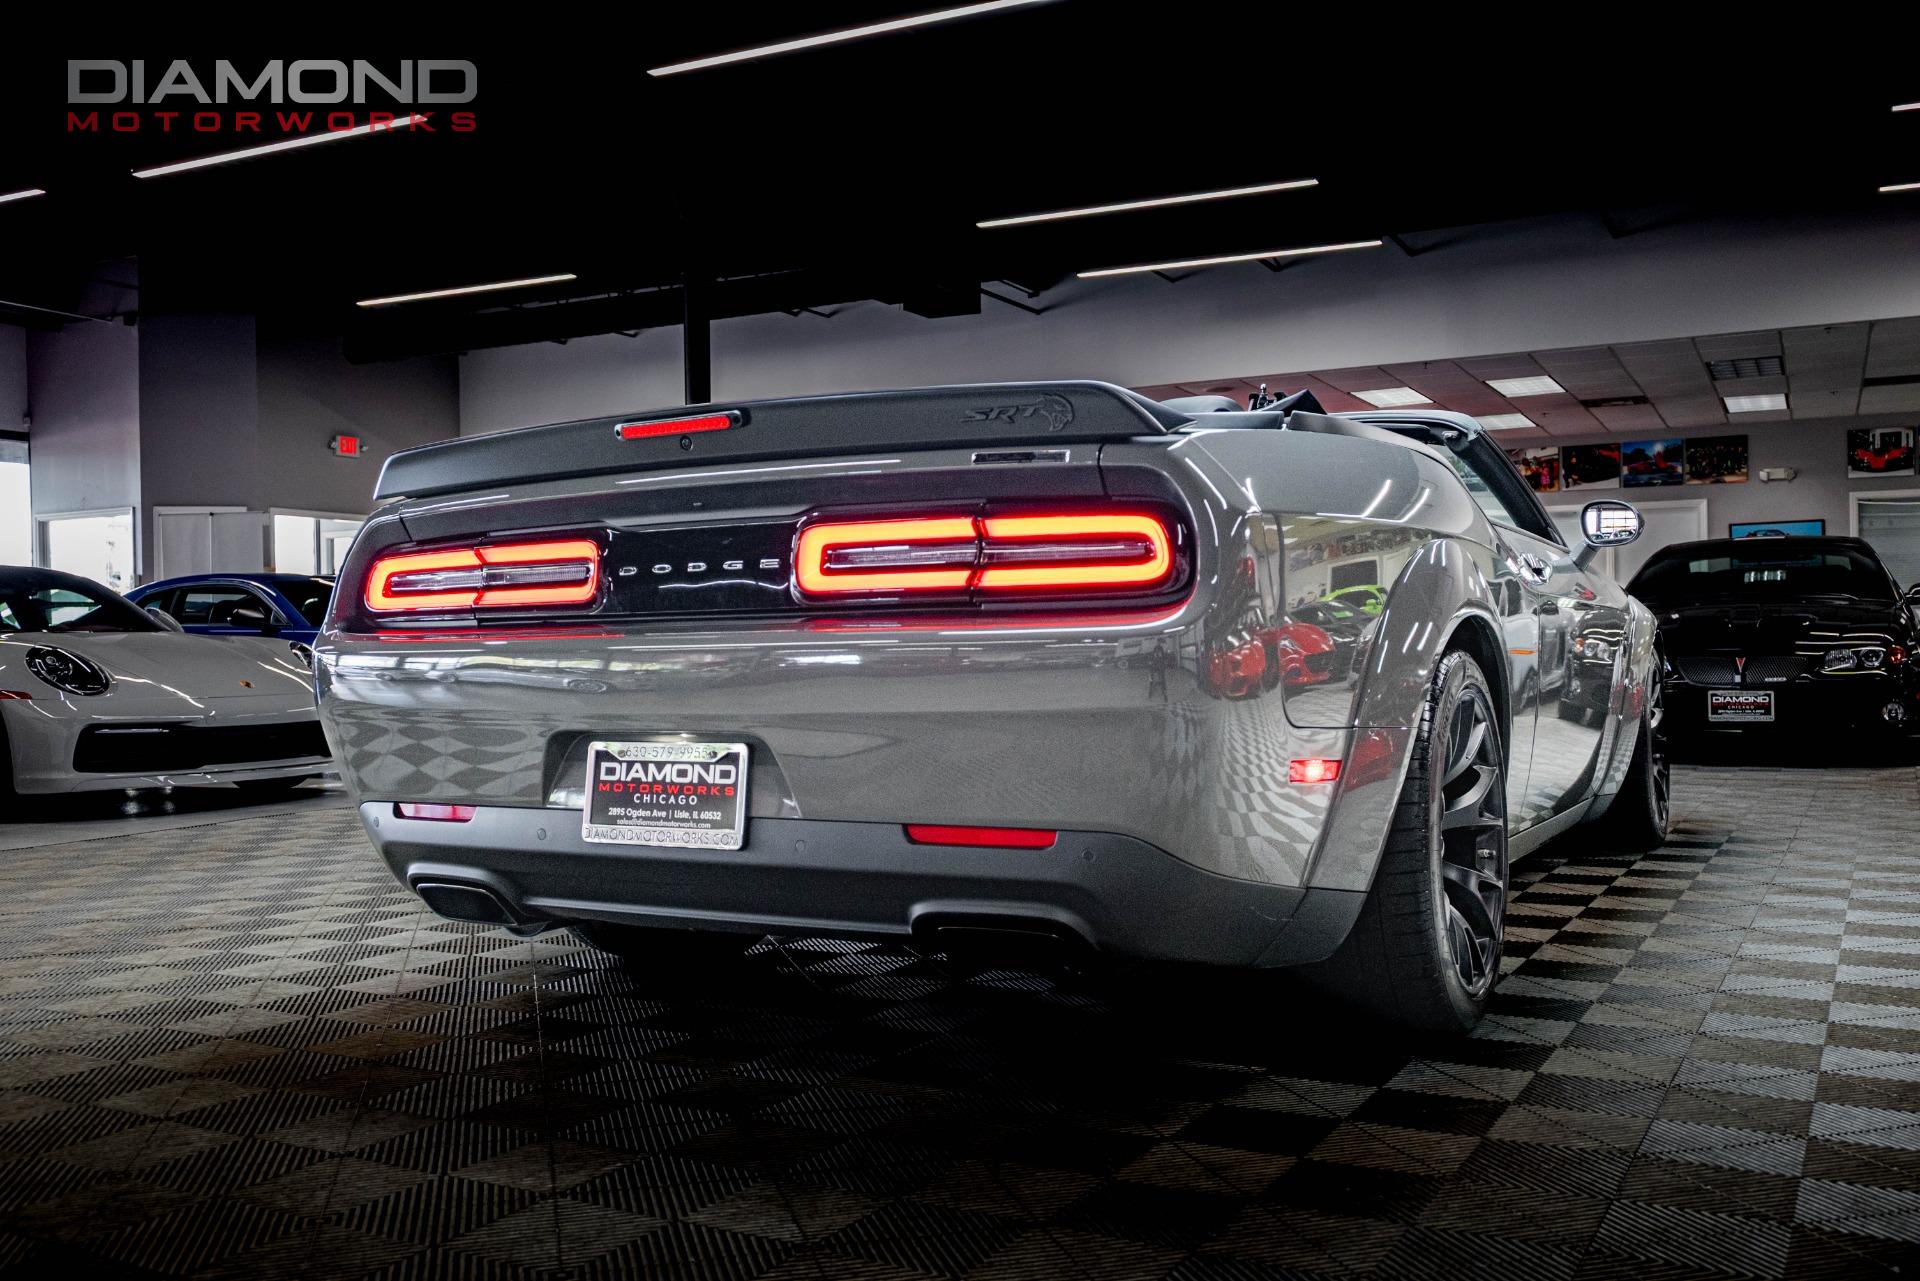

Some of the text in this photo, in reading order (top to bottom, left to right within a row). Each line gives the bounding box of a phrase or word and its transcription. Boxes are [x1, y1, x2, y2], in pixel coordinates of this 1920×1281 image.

[961, 404, 1041, 424] SRT
[619, 559, 780, 576] DODGE
[600, 762, 736, 784] DIAMOND
[598, 783, 735, 796] MOTORWORKS
[633, 794, 698, 805] CHICAGO
[608, 808, 625, 816] 2895
[626, 808, 651, 818] Ogden
[652, 809, 667, 818] Ave
[700, 811, 721, 820] 60532
